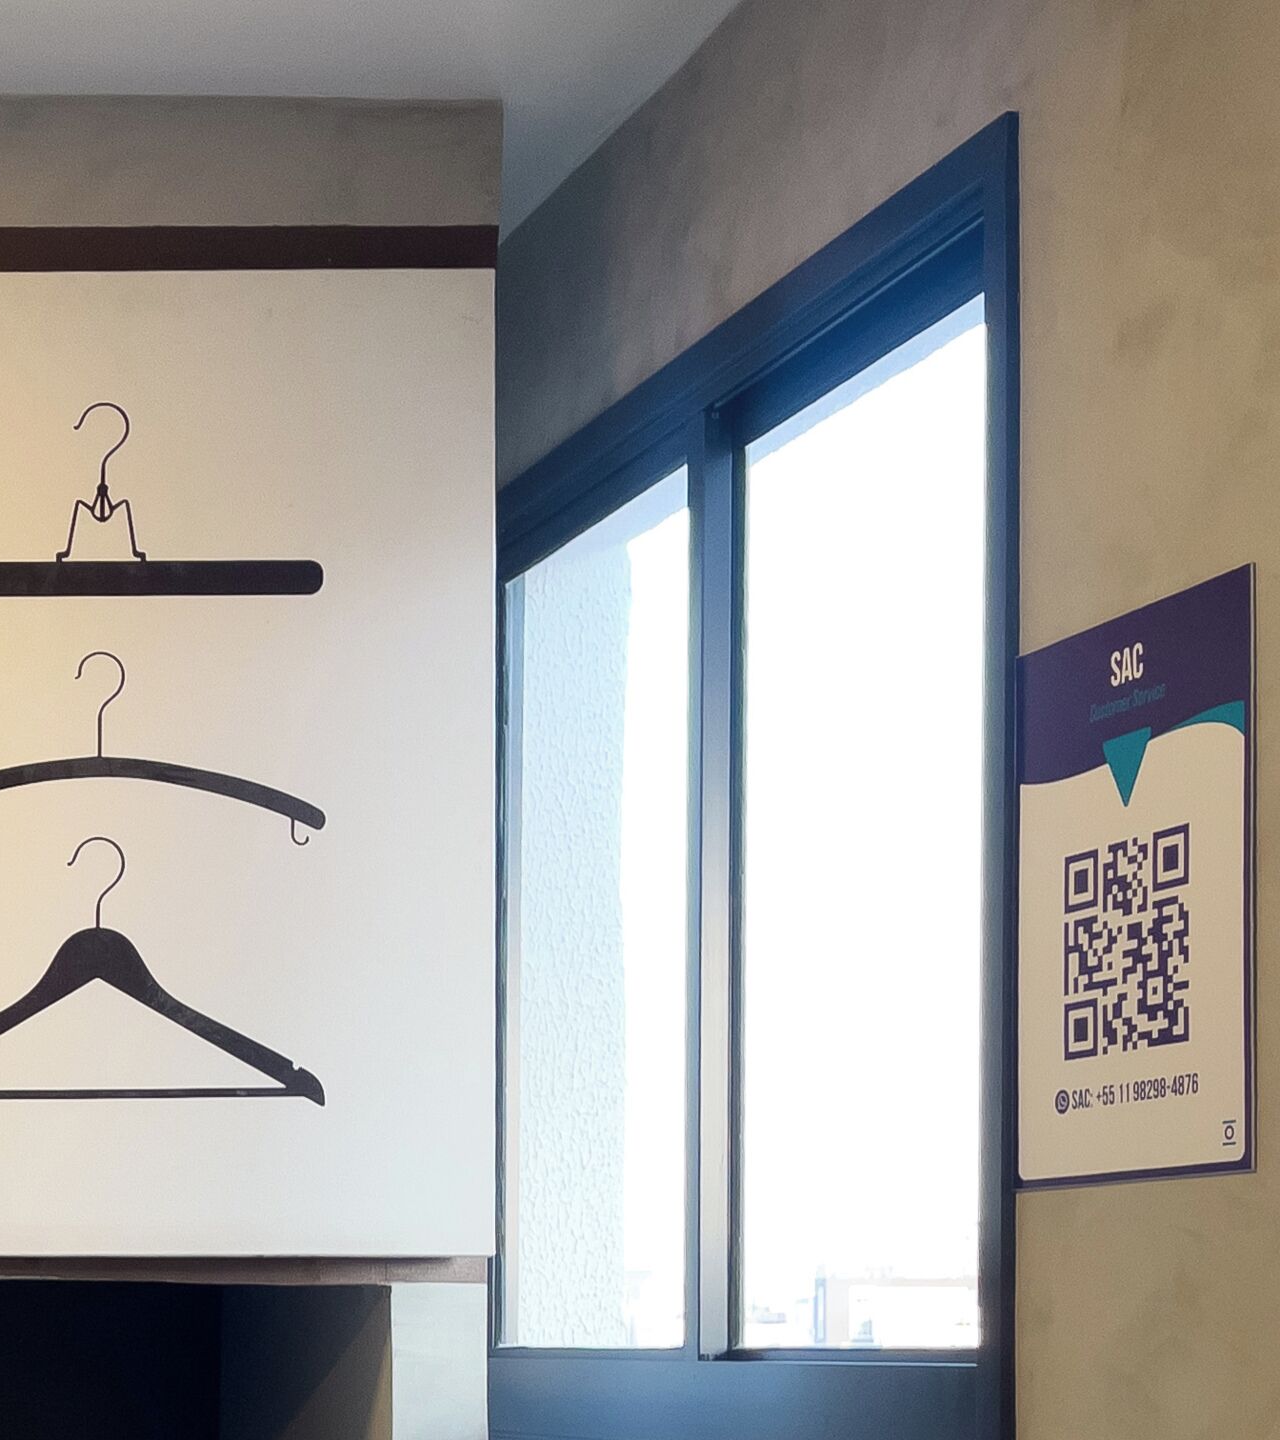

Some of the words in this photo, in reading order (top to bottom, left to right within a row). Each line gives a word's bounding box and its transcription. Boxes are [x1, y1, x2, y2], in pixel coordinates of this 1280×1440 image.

[1110, 642, 1144, 687] SAC
[1071, 1089, 1093, 1109] SAC:
[1096, 1085, 1115, 1106] +55
